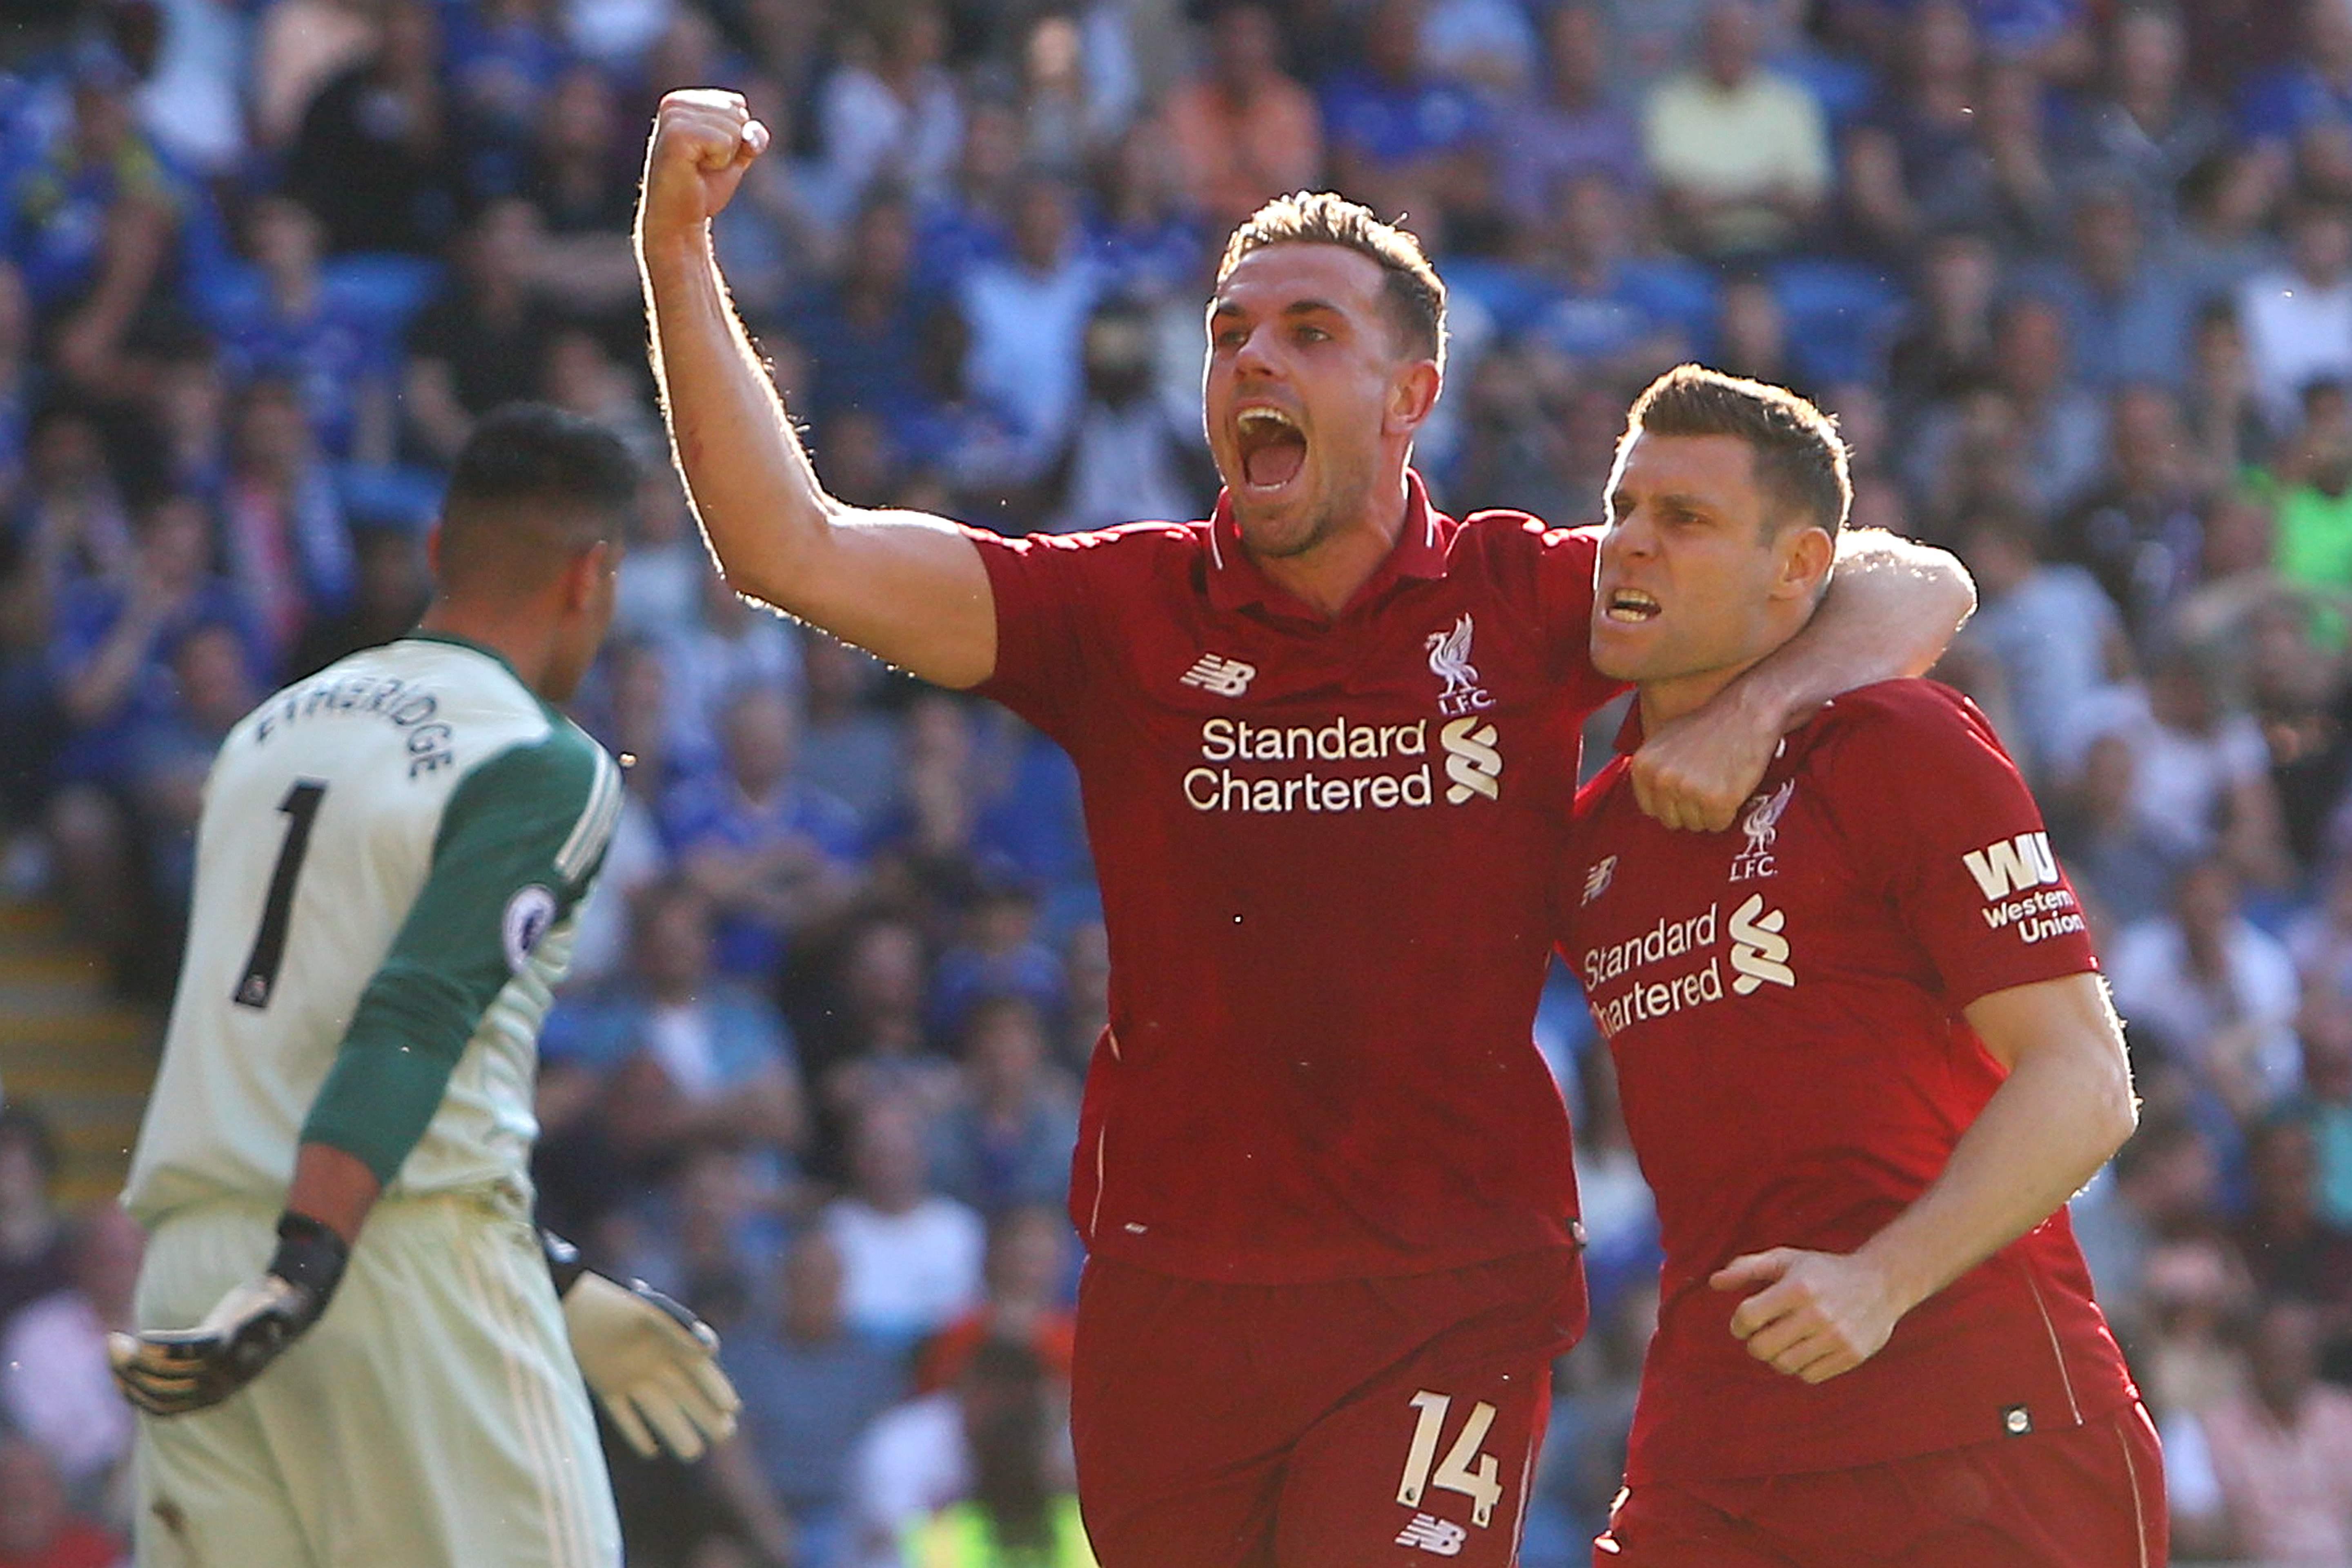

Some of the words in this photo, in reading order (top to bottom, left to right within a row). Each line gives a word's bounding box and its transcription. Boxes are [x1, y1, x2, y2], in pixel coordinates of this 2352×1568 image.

[1202, 717, 1427, 760] Standard
[1183, 764, 1432, 811] Chartered
[234, 778, 328, 1009] 1
[1962, 831, 2058, 901] WU
[1982, 890, 2074, 928] Western
[2018, 911, 2084, 944] Union
[1584, 903, 1717, 991] Standard
[1590, 957, 1724, 1038] hartered
[1396, 1390, 1503, 1528] 14
